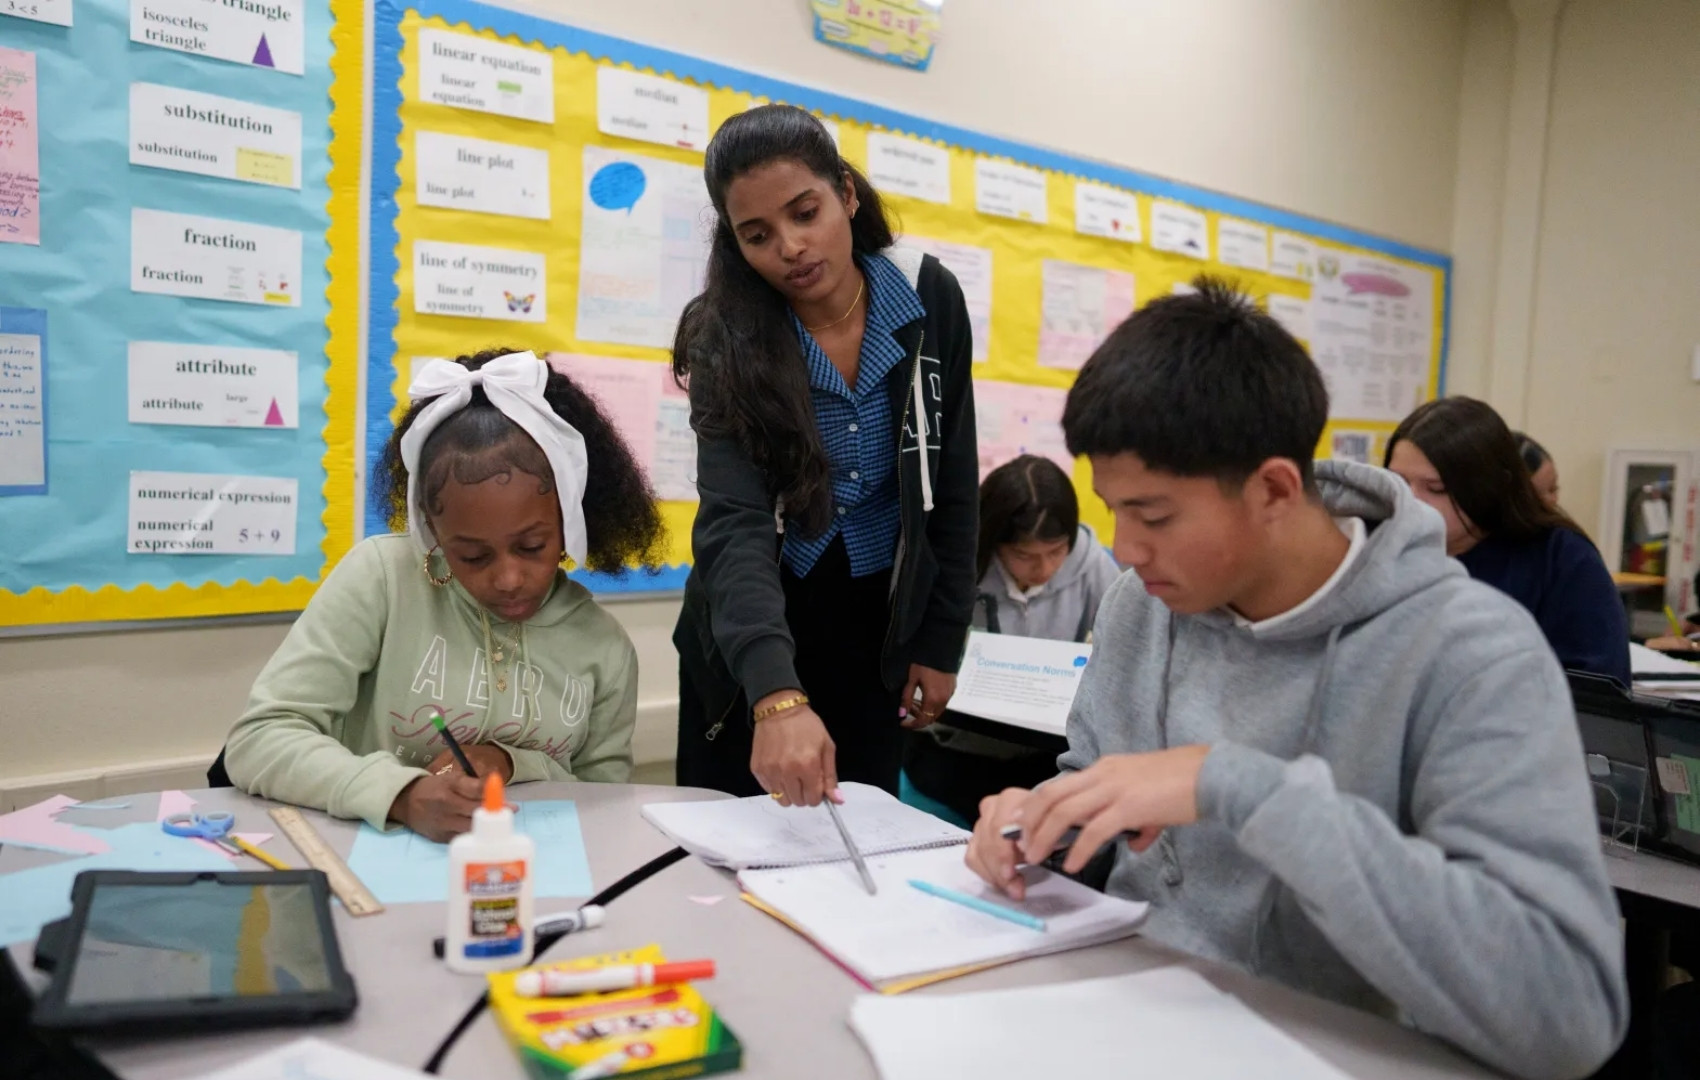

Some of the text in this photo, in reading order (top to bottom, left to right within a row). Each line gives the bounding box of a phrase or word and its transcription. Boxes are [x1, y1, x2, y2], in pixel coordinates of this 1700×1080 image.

[8, 0, 15, 11] 3
[30, 5, 38, 15] 5
[223, 0, 292, 22] triangle
[143, 7, 209, 32] isosceles
[145, 28, 207, 51] triangle
[432, 41, 542, 76] linear equation
[441, 73, 476, 89] linear
[432, 91, 486, 107] equation
[164, 104, 273, 135] substitution
[137, 142, 218, 164] substitution
[457, 148, 514, 170] line plot
[426, 182, 475, 199] line plot
[184, 228, 257, 252] fraction
[142, 266, 204, 285] fraction
[420, 252, 538, 280] line of symmetry
[437, 283, 474, 297] line of
[426, 300, 485, 315] symmetry
[176, 359, 257, 377] attribute
[142, 397, 204, 412] attribute
[138, 487, 291, 506] numerical expression
[137, 519, 213, 533] numerical
[238, 528, 281, 543] 5 + 9
[135, 537, 214, 552] expression
[977, 657, 1076, 678] Conversation Norms
